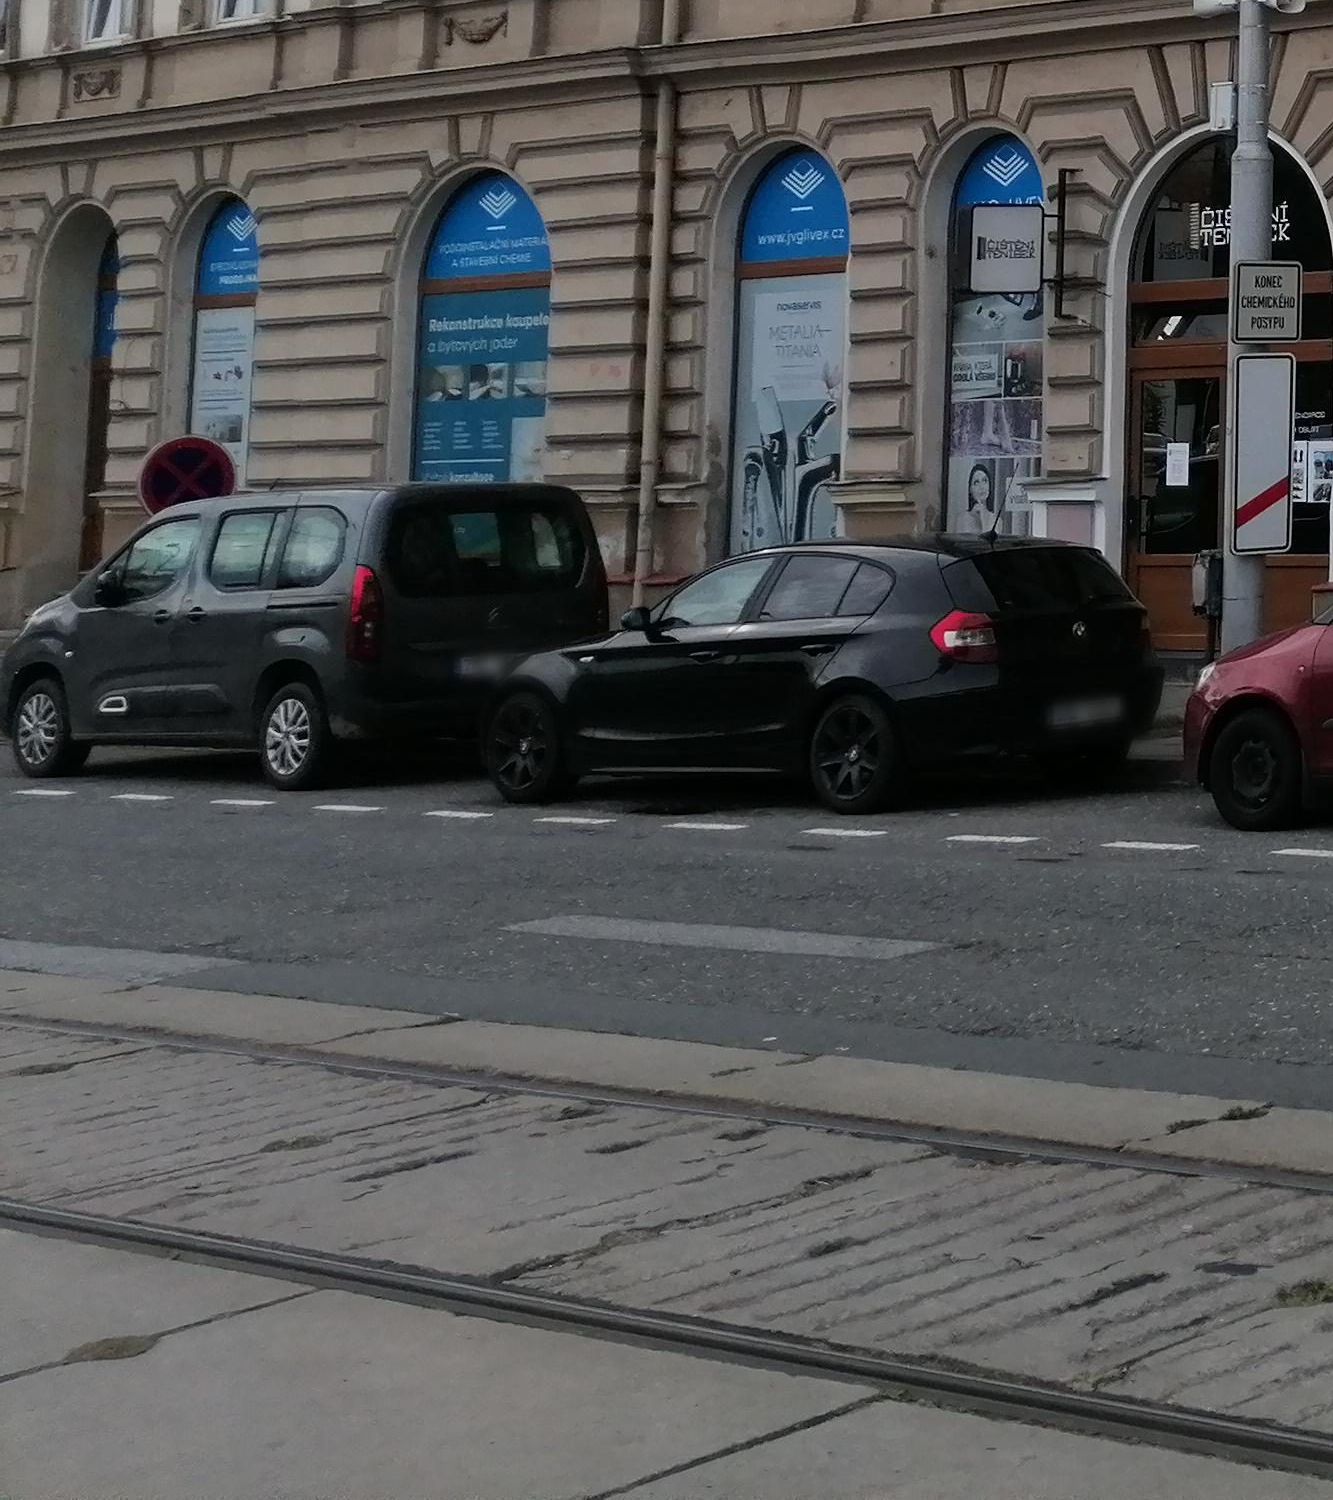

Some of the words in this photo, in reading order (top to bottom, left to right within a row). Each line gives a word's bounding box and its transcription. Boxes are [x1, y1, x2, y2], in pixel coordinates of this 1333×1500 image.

[1254, 275, 1283, 288] KONEC
[1241, 293, 1295, 308] CHEMICKÉHO
[1251, 316, 1285, 329] POSYPU
